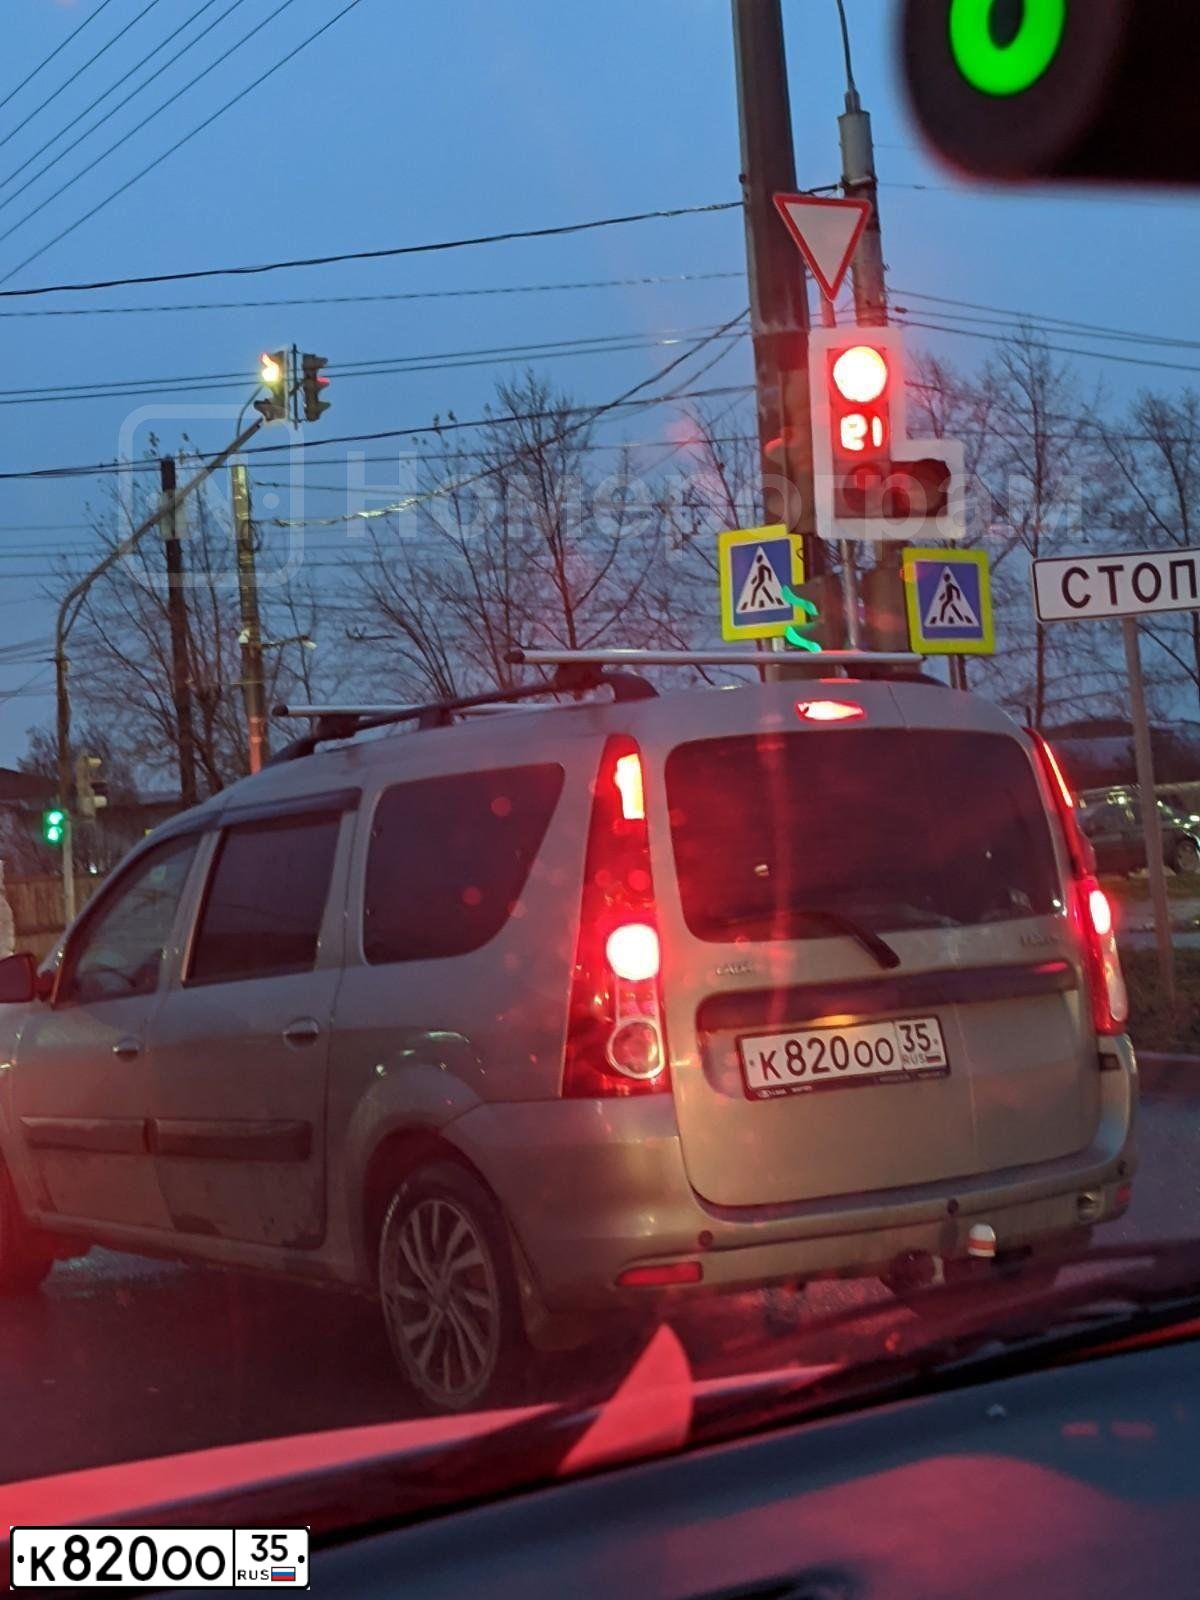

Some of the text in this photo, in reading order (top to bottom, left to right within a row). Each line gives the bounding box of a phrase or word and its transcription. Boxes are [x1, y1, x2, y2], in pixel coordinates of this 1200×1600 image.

[1061, 558, 1198, 608] СТОП
[899, 1023, 932, 1052] 35
[902, 1052, 926, 1065] RUS
